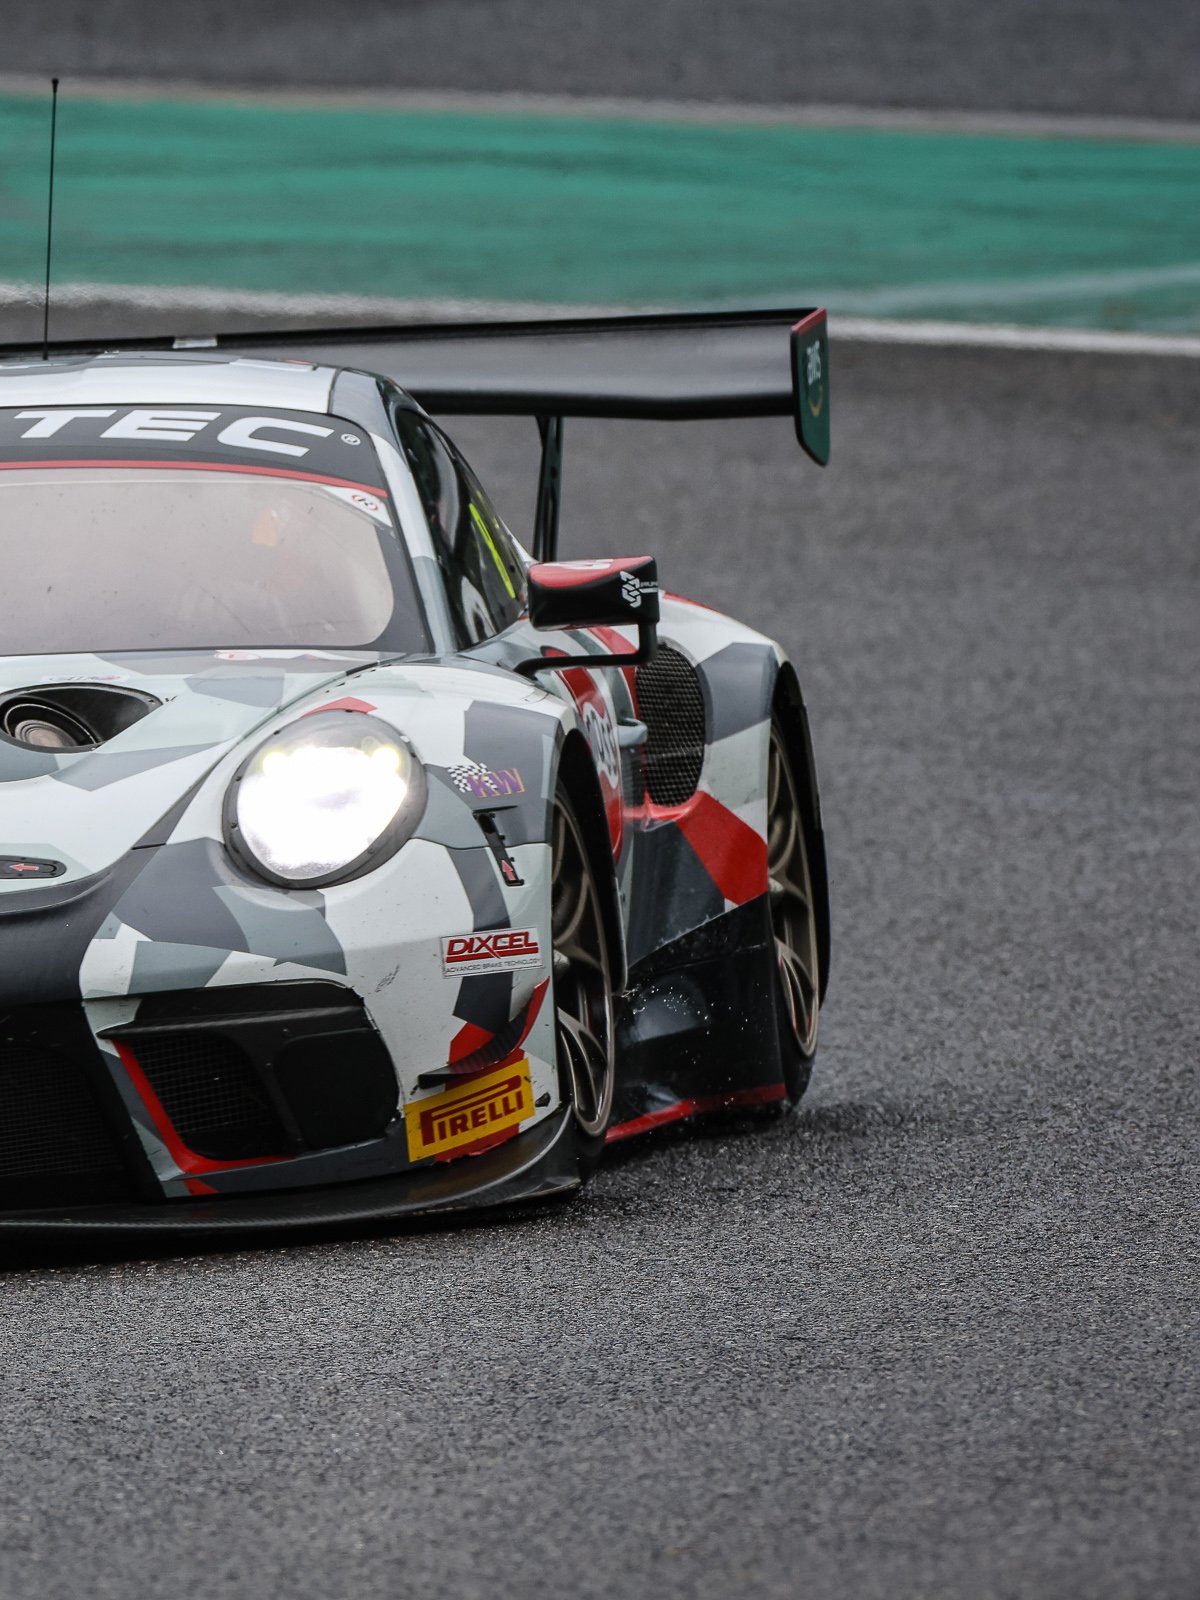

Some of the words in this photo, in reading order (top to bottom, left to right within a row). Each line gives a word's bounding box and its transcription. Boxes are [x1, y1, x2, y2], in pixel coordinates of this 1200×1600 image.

[467, 767, 525, 797] KW
[447, 931, 538, 959] DIXCEL
[420, 1075, 524, 1147] PIRELLI
